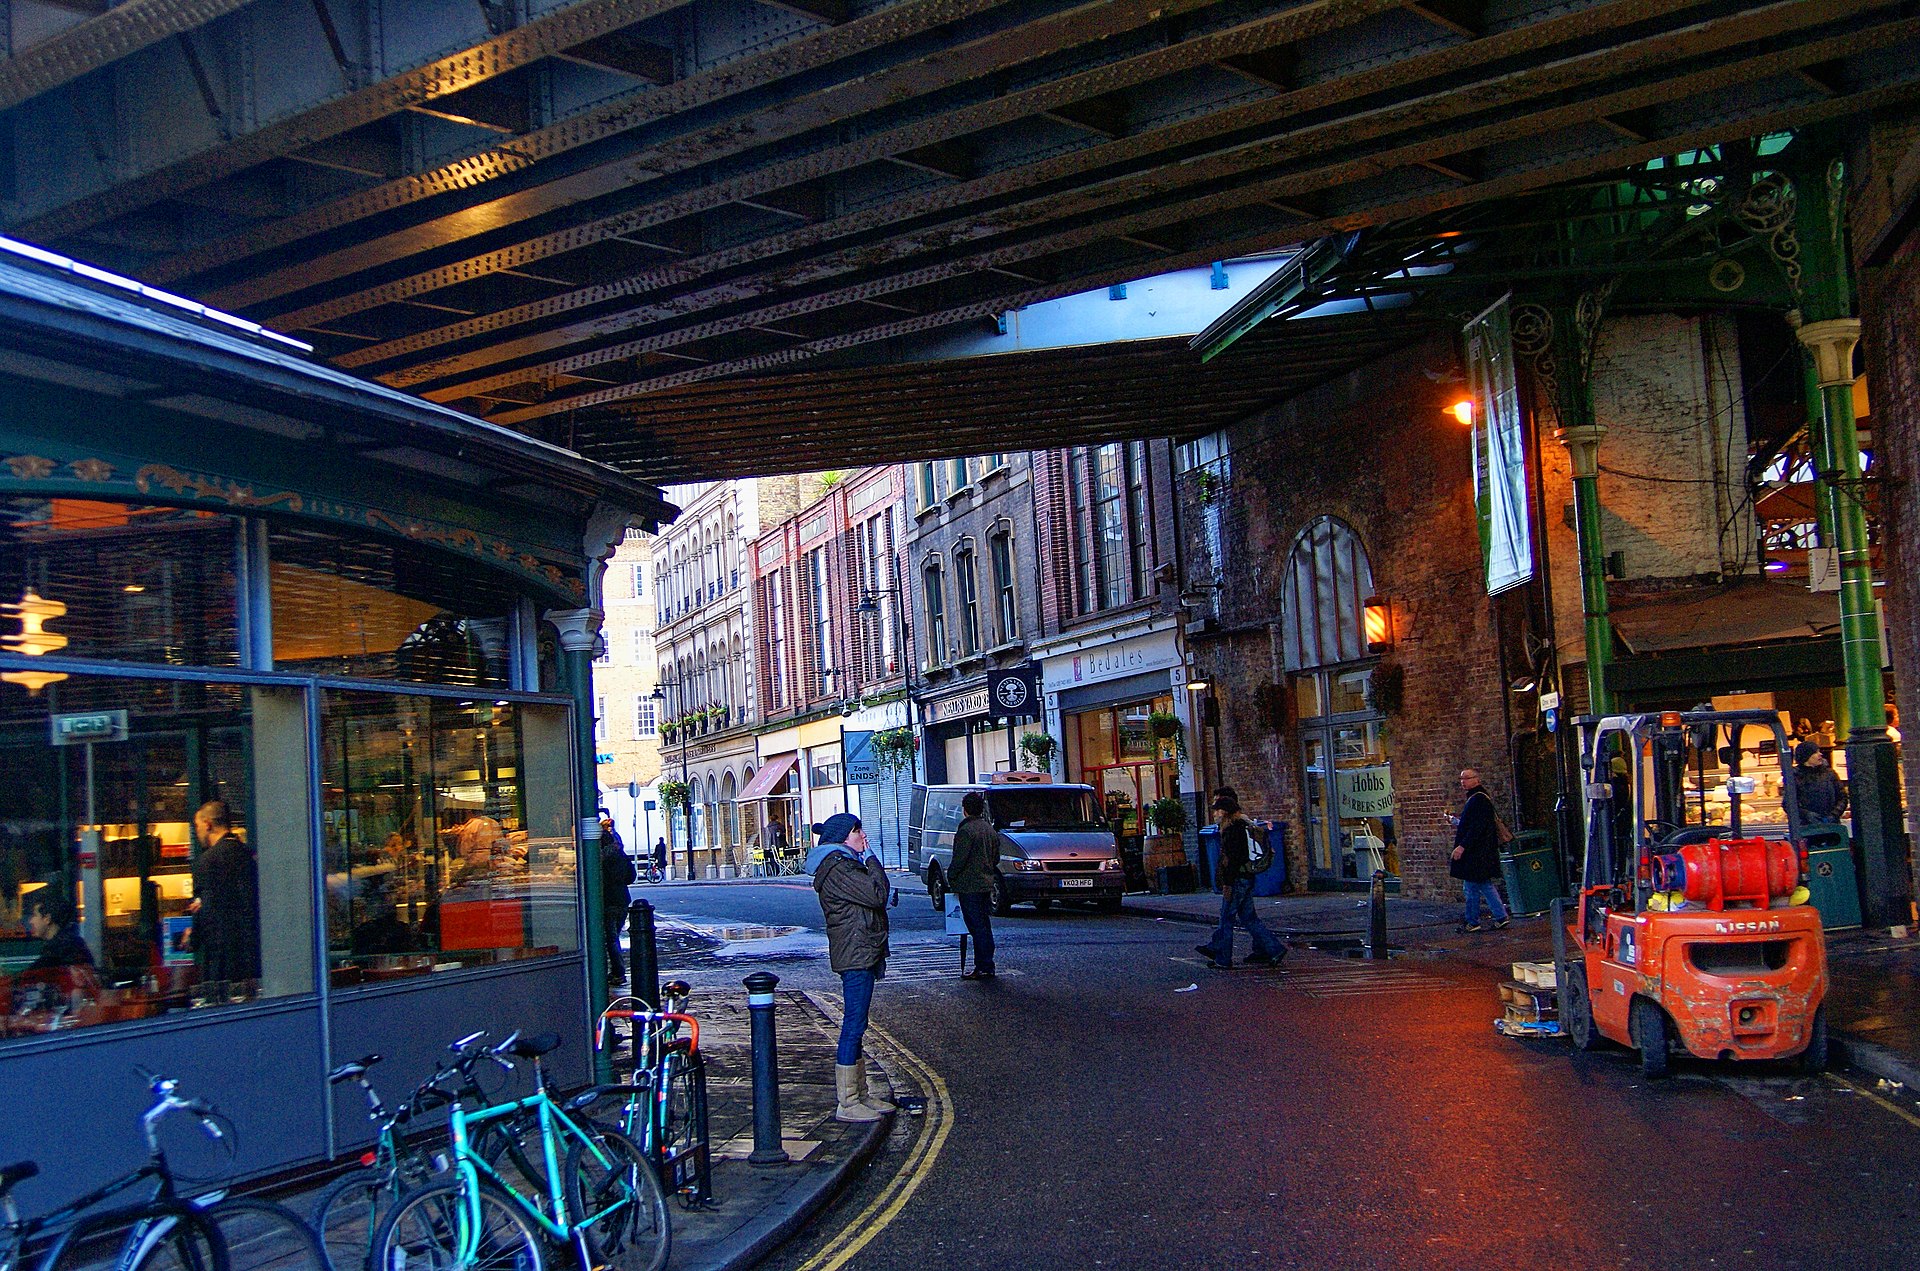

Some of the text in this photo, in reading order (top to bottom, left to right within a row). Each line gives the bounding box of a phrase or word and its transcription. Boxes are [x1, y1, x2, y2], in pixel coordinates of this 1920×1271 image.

[1089, 645, 1143, 674] Bedales
[964, 694, 981, 710] YARD
[1352, 772, 1385, 792] Hobbs
[1342, 793, 1376, 813] BARBERS
[1716, 921, 1779, 933] NISSAN
